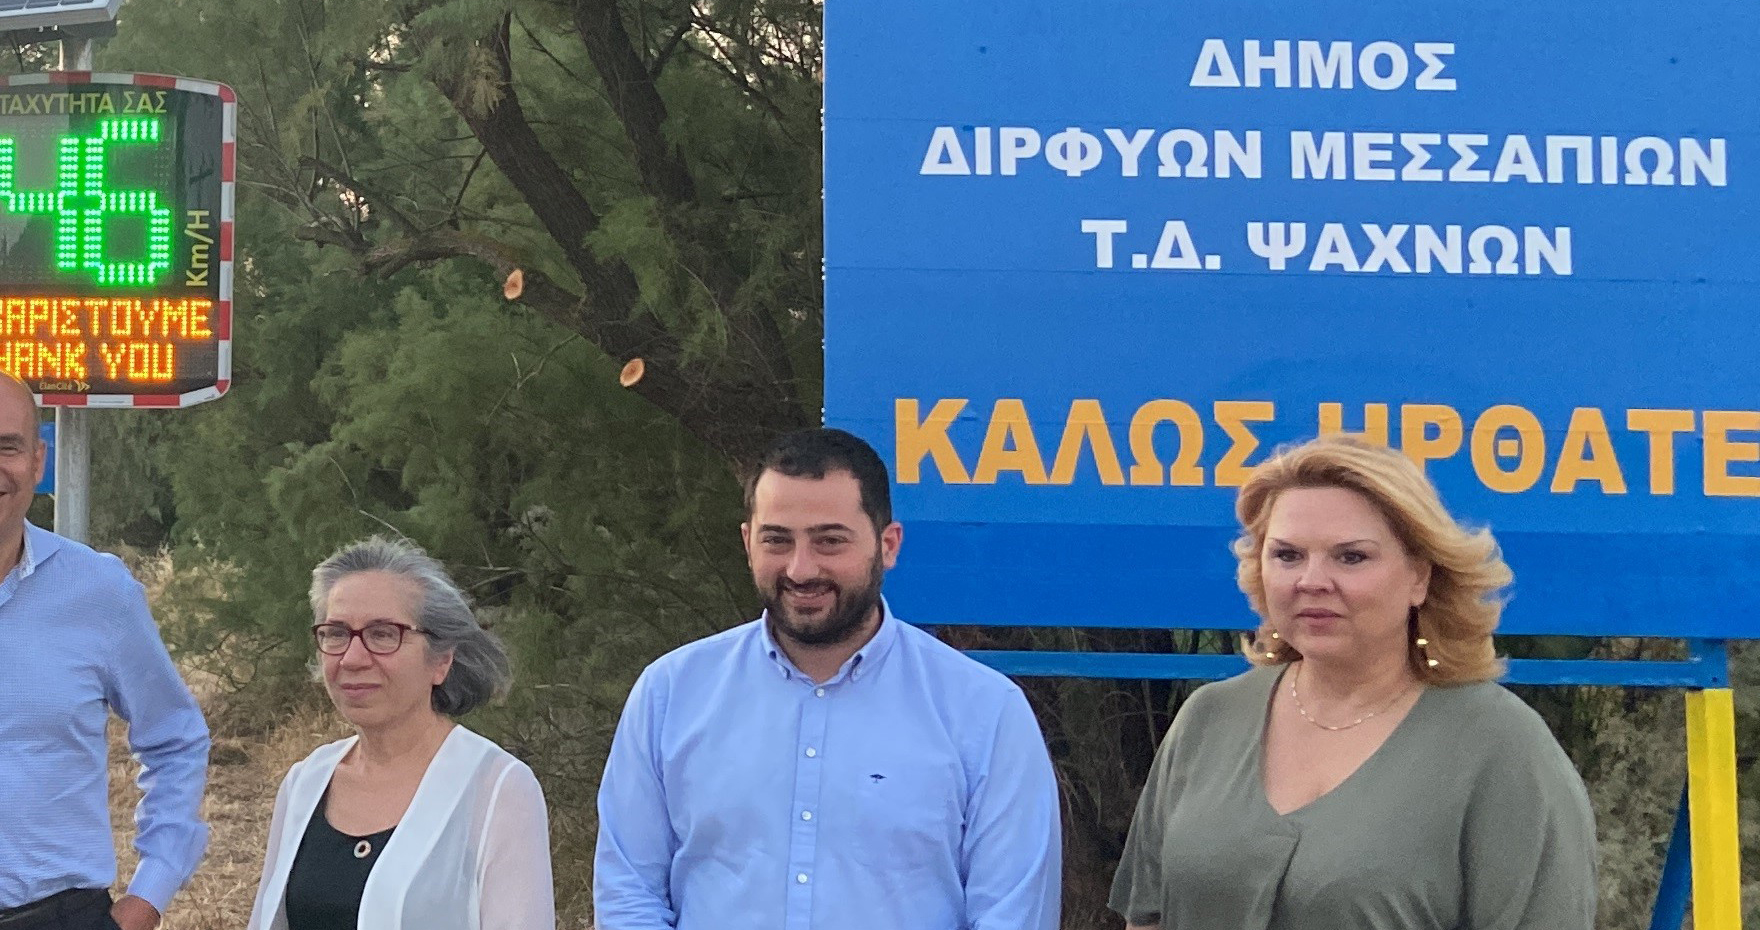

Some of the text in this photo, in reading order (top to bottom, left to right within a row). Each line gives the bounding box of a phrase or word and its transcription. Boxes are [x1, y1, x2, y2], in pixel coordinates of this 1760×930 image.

[1189, 38, 1457, 92] ΔΗΜΟΣ
[123, 90, 167, 114] ΣΑΣ
[919, 126, 1728, 188] ΔΙΡΦΥΩΝ ΜΕΣΣΑΠΙΩΝ
[185, 210, 214, 287] Km/H
[1081, 219, 1574, 277] Τ.Δ. ΨΑΧΝΩΝ
[101, 342, 175, 380] YOU
[894, 398, 1275, 487] ΚΑΛΩΣ
